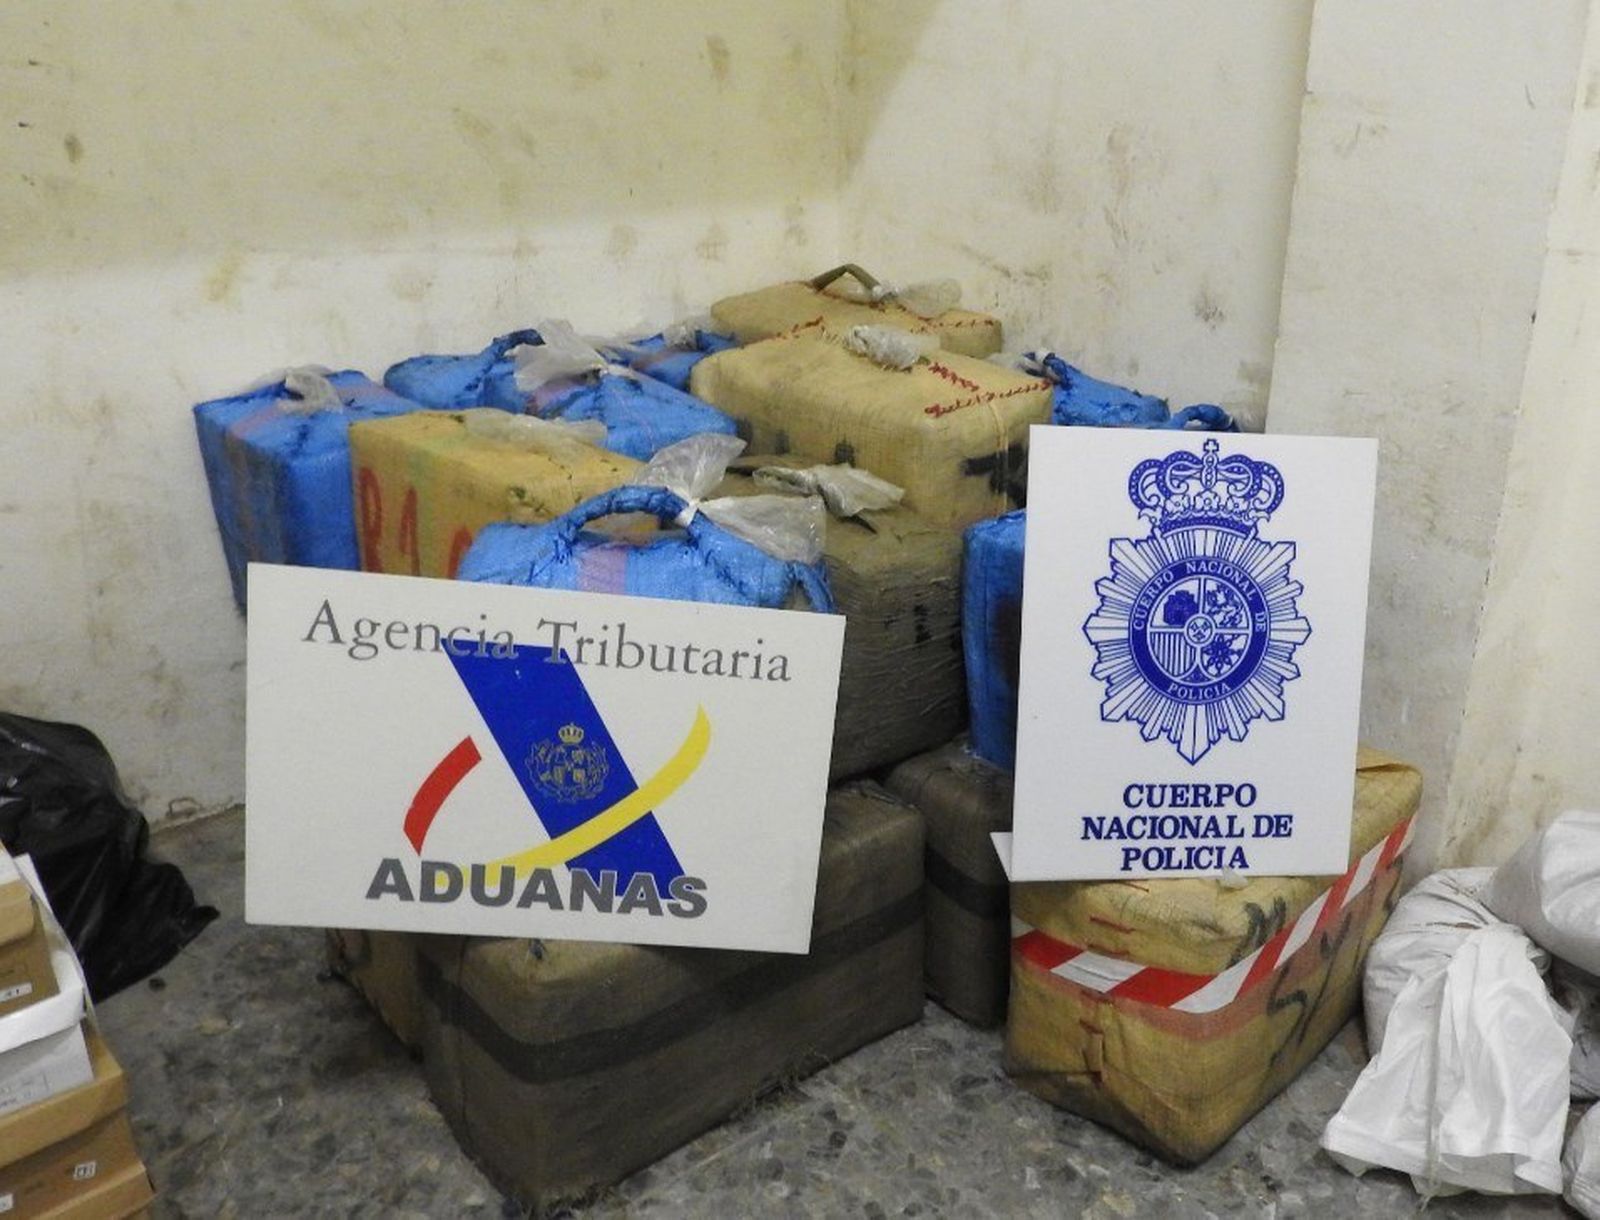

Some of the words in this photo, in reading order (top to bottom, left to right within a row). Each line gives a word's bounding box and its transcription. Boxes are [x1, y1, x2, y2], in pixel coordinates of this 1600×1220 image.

[1132, 570, 1175, 630] CUERPO
[1185, 560, 1258, 601] NACIONAL
[1254, 612, 1267, 632] DE
[302, 599, 520, 661] Agencia
[536, 617, 793, 682] Tributaria
[1166, 682, 1232, 701] POLICIA
[1123, 783, 1257, 808] CUERPO
[1081, 815, 1245, 840] NACIONAL
[1252, 814, 1294, 838] DE
[1121, 846, 1249, 871] POLICIA
[365, 857, 709, 920] ADUANAS
